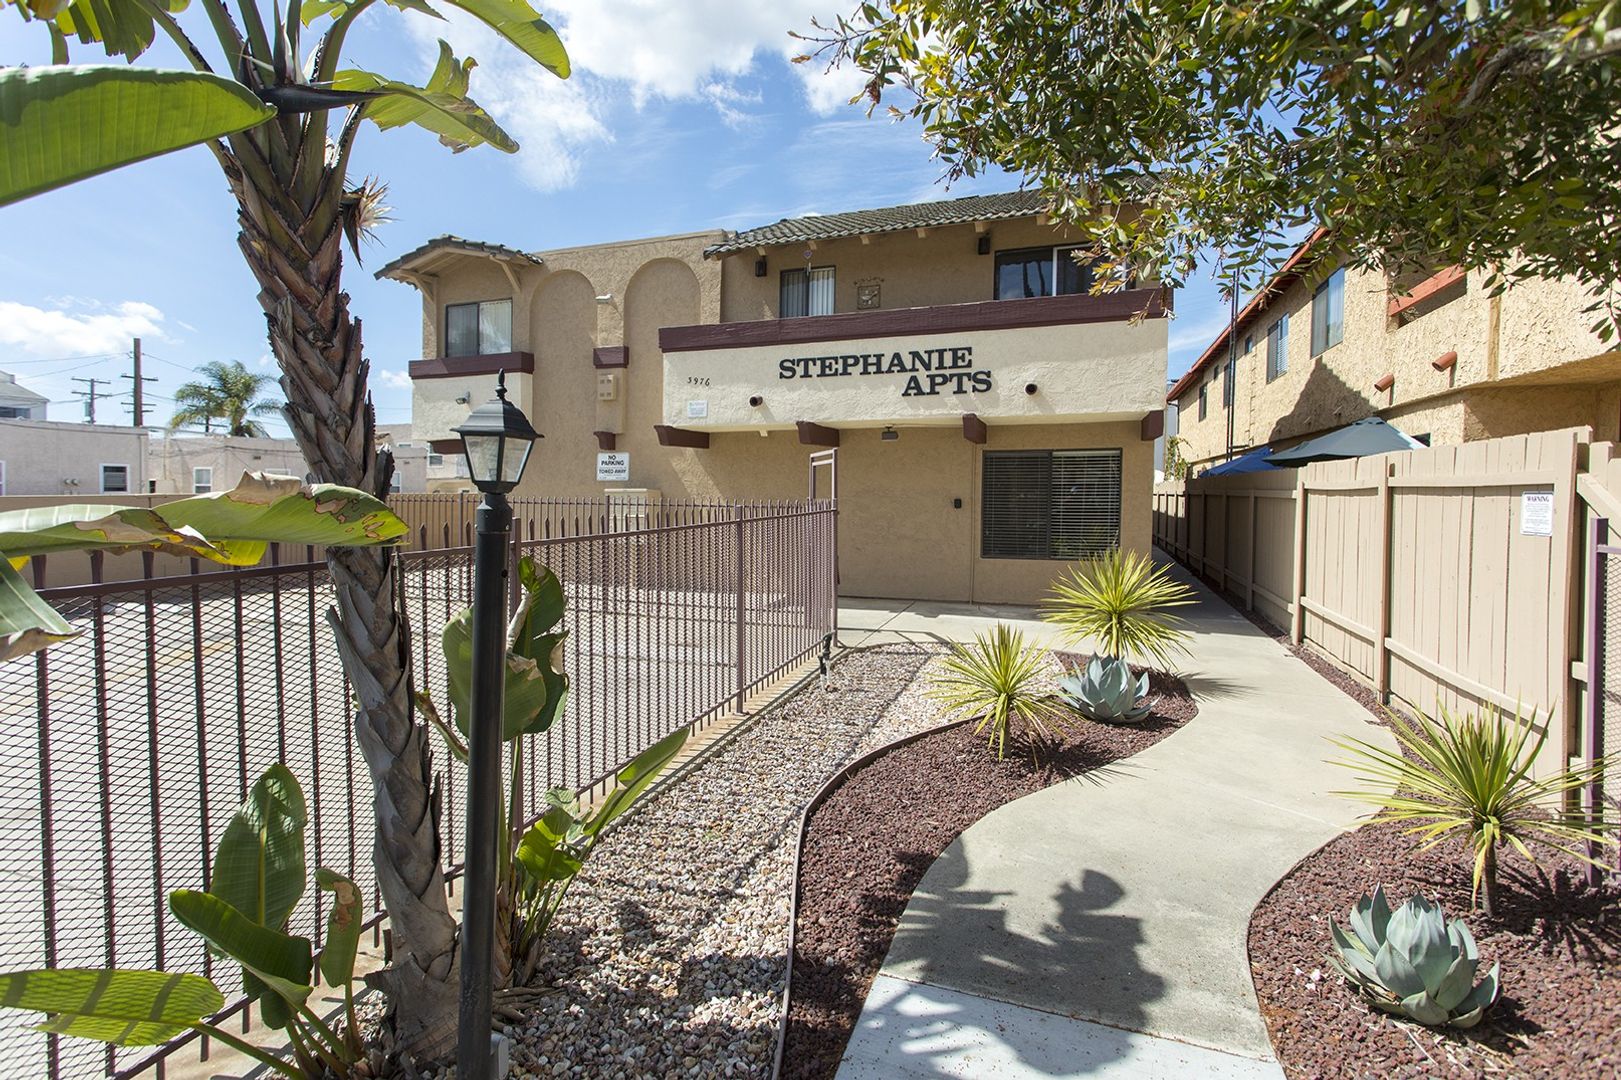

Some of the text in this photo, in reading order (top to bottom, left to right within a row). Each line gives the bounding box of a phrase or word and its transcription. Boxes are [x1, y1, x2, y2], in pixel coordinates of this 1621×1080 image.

[779, 347, 973, 379] STEPHANIE
[687, 376, 710, 387] 3976
[902, 370, 992, 397] APTS
